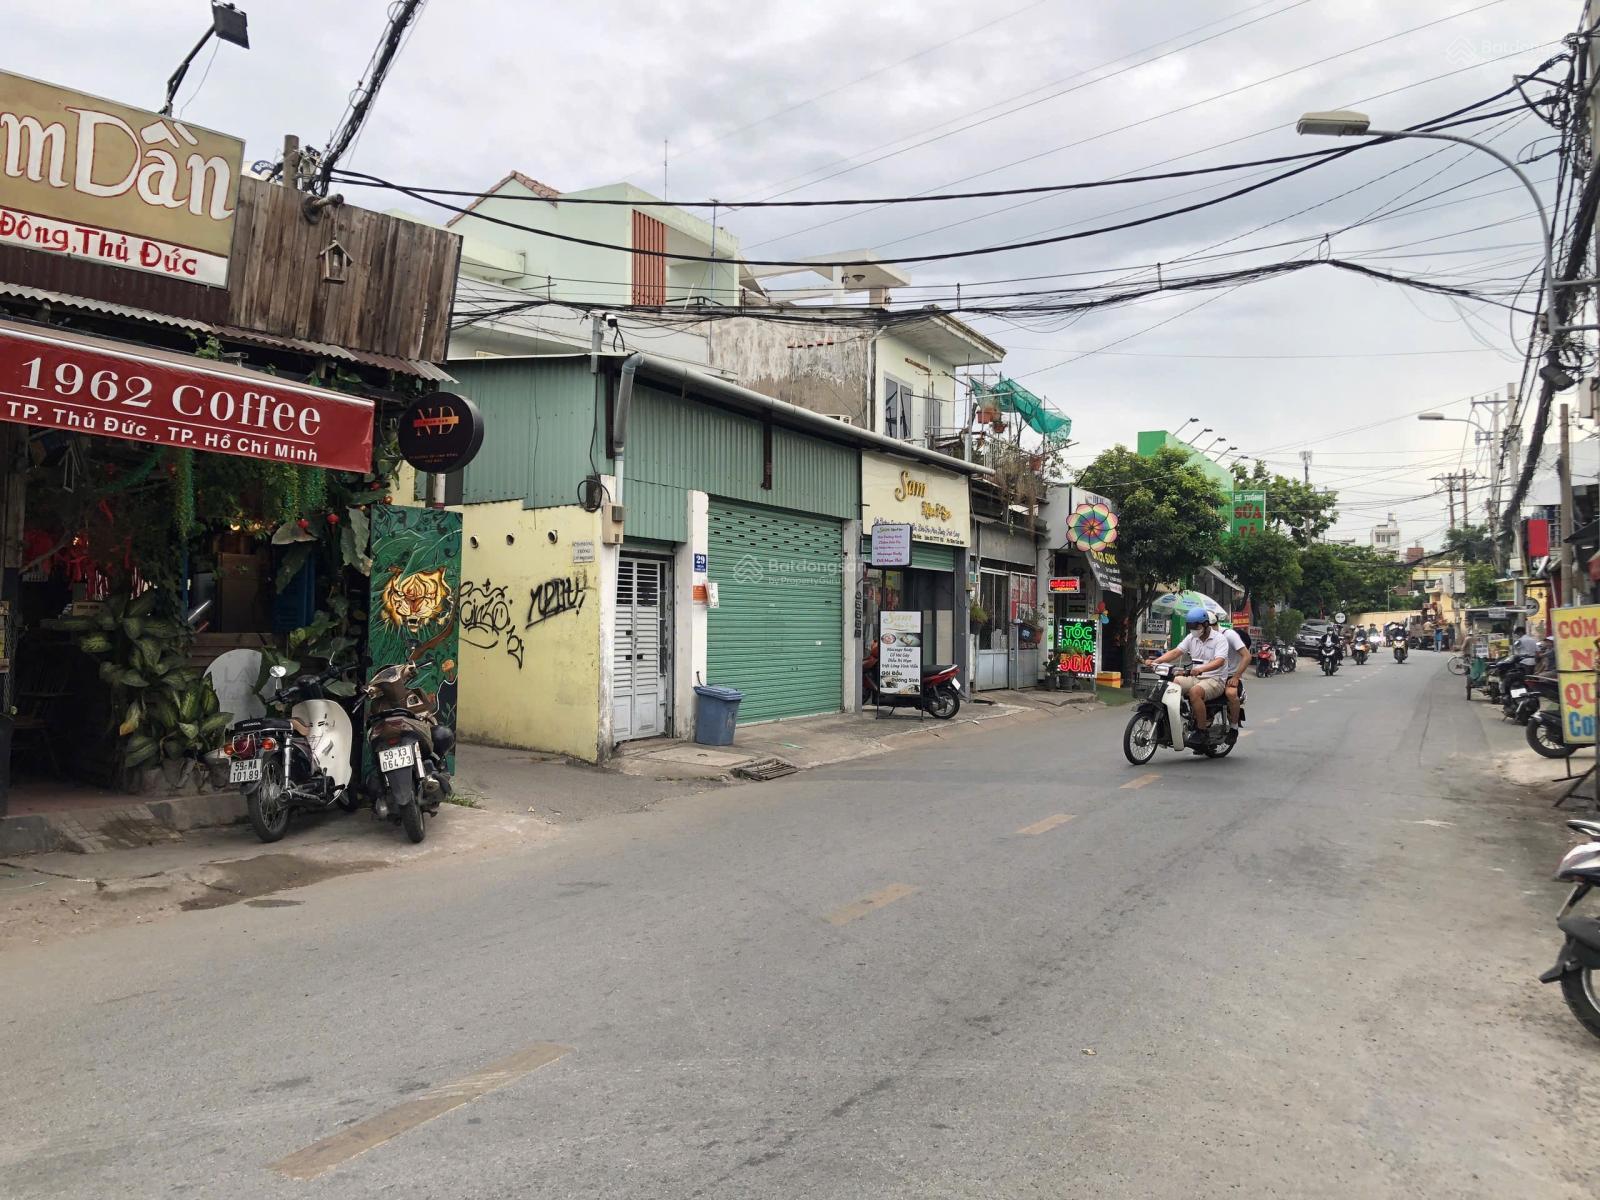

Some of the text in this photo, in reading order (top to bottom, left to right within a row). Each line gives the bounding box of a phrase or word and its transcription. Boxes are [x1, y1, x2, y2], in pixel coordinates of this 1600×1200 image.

[139, 241, 198, 276] Đức
[21, 356, 322, 436] 1962 Coffee
[7, 401, 43, 422] TP.
[53, 407, 96, 430] Thủ
[103, 413, 148, 437] Đức
[168, 426, 198, 445] TP.
[205, 430, 232, 450] Hồ
[236, 437, 269, 456] Chí
[275, 442, 319, 463] Minh
[696, 554, 705, 565] 29
[1063, 622, 1093, 639] TÓC
